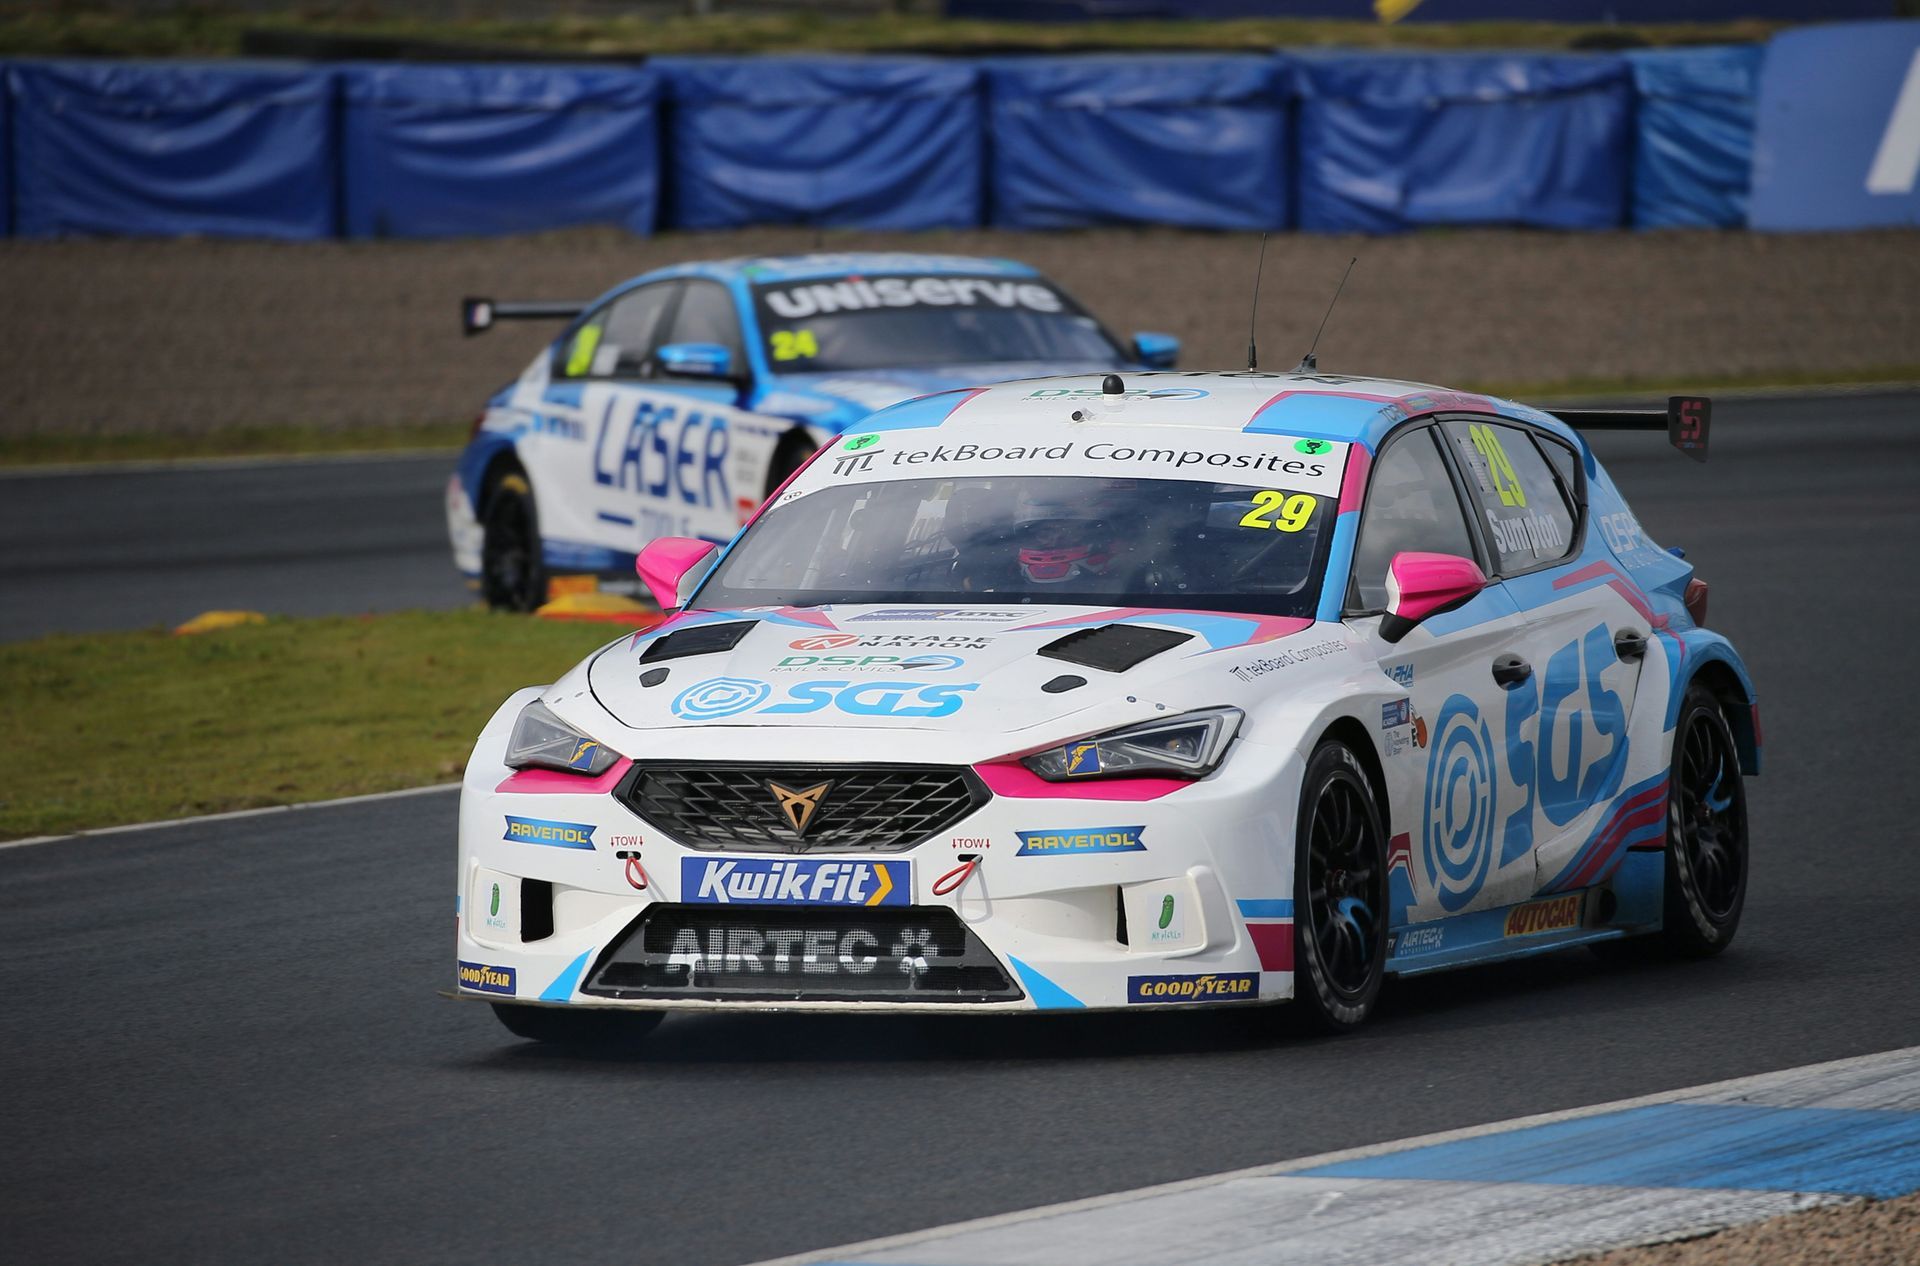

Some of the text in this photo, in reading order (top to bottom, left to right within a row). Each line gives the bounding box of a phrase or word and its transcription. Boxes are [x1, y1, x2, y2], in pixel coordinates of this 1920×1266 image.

[770, 329, 818, 361] 24
[594, 395, 732, 512] LASER
[892, 442, 1326, 477] tekBoard Composites
[1469, 424, 1526, 508] 29
[1239, 490, 1318, 533] 29
[1486, 508, 1563, 559] Sumpton
[857, 641, 987, 649] NATION
[871, 634, 996, 642] TRADE
[777, 655, 901, 667] DSP
[1246, 640, 1347, 676] tekBoard Composites
[753, 680, 981, 718] SGS
[1498, 622, 1630, 870] SGS
[510, 822, 588, 844] RAVENOL
[614, 836, 638, 847] TOW
[957, 838, 984, 849] TOW
[1027, 833, 1135, 850] RAVENOL
[1506, 896, 1579, 936] AUTOCAR
[665, 928, 878, 974] AIRTEC
